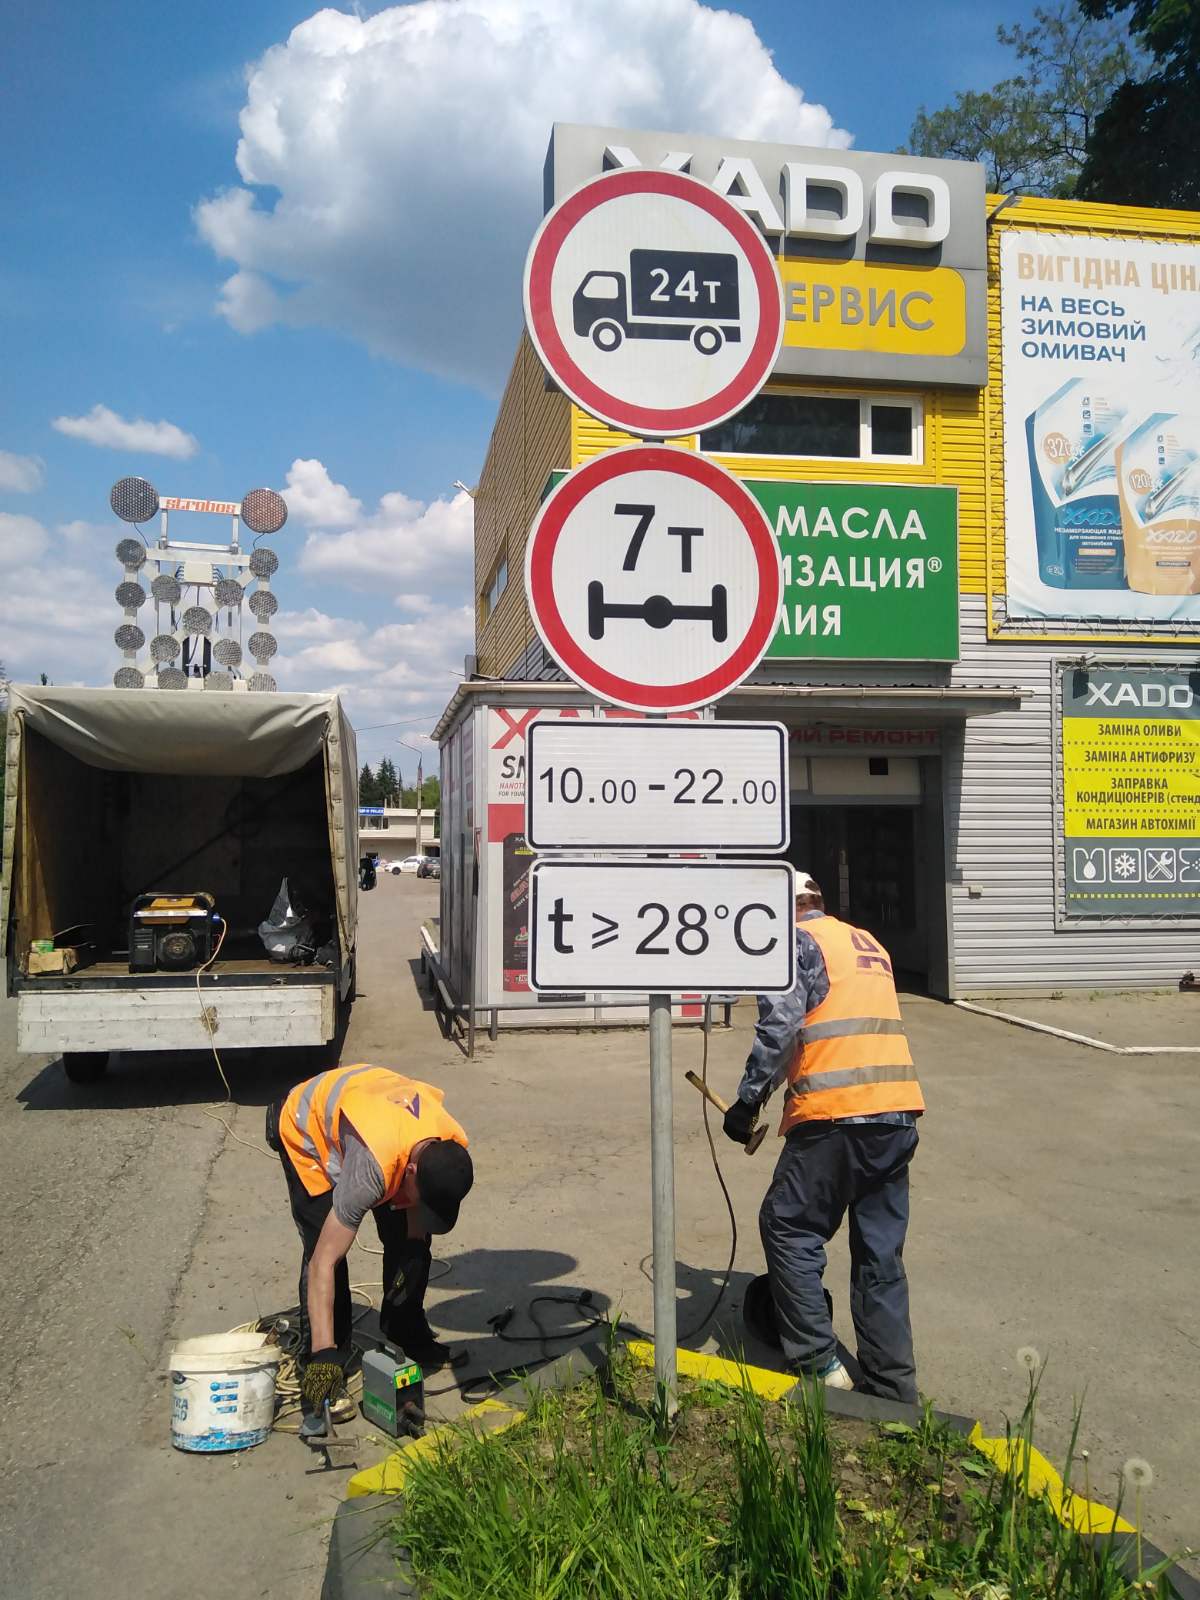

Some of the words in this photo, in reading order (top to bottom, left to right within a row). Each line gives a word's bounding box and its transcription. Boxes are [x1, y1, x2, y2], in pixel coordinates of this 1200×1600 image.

[1017, 252, 1141, 290] ВИГІДНА
[1151, 262, 1200, 294] ЦІН
[1021, 295, 1054, 313] НА
[1061, 297, 1125, 317] ВЕСЬ
[1021, 318, 1146, 341] ЗИМОВИЙ
[1021, 341, 1126, 363] ОМИВАЧ
[776, 505, 927, 540] МАСЛА
[1085, 682, 1194, 708] XADO
[1098, 724, 1141, 737] ЗАМІНА
[1143, 725, 1182, 737] ОЛИВИ
[1085, 751, 1127, 762] ЗАМІНА
[1130, 751, 1195, 764] АНТИФРИЗУ
[1111, 778, 1169, 789] ЗАПРАВКА
[1077, 792, 1165, 805] КОНДИЦІОНЕРІВ
[1086, 818, 1138, 830] МАГАЗИН
[1141, 816, 1196, 830] АВТОХІМІЇ
